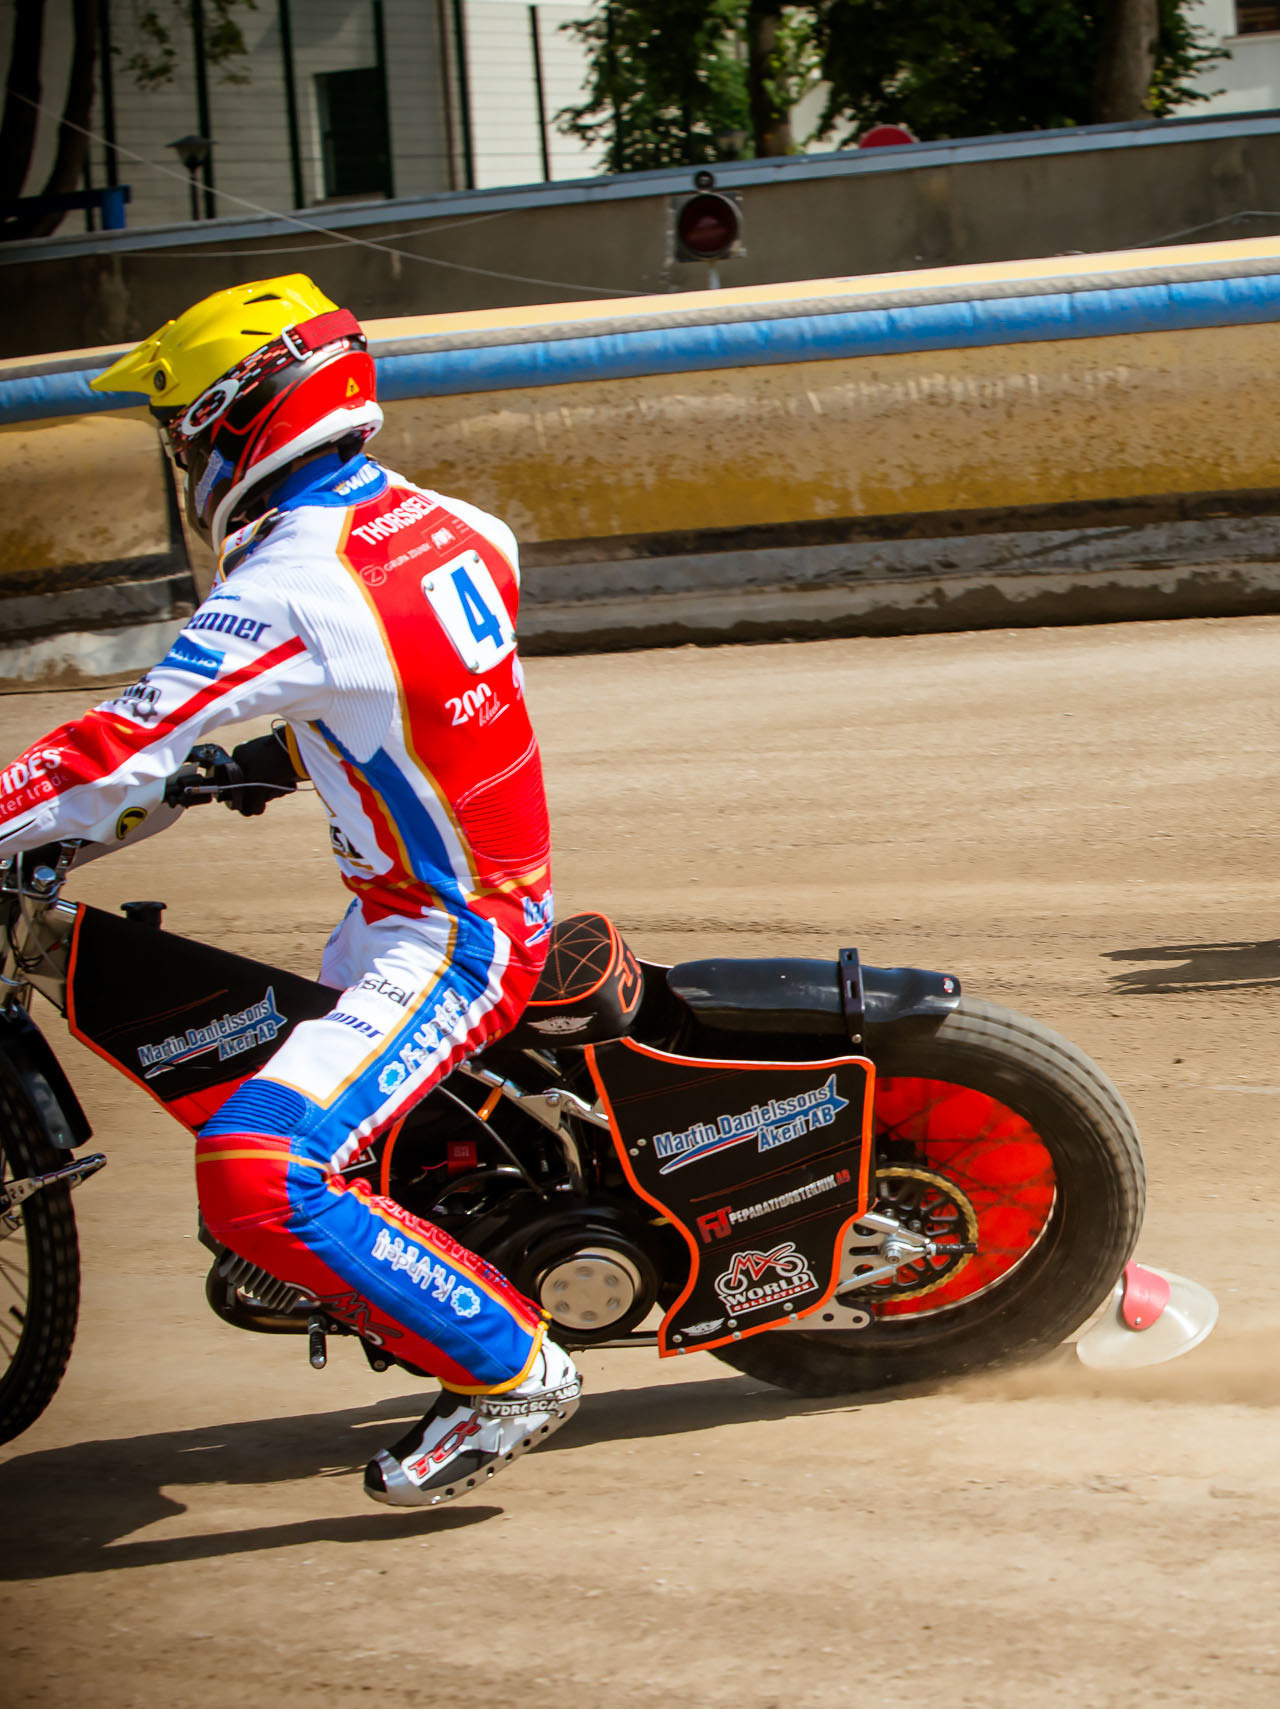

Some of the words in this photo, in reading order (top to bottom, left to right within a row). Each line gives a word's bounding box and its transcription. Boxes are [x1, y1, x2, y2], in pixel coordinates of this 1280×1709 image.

[451, 566, 504, 648] 4
[138, 1035, 187, 1067] Martin
[186, 999, 271, 1049] Danielssons
[218, 1028, 257, 1061] Åkeri
[257, 1019, 278, 1045] AB
[653, 1122, 717, 1159] Martin
[717, 1086, 829, 1138] Danielssons
[757, 1116, 808, 1153] Åkeri
[808, 1104, 836, 1132] AB
[726, 1273, 810, 1306] WORLD
[732, 1281, 813, 1312] COLLECTION
